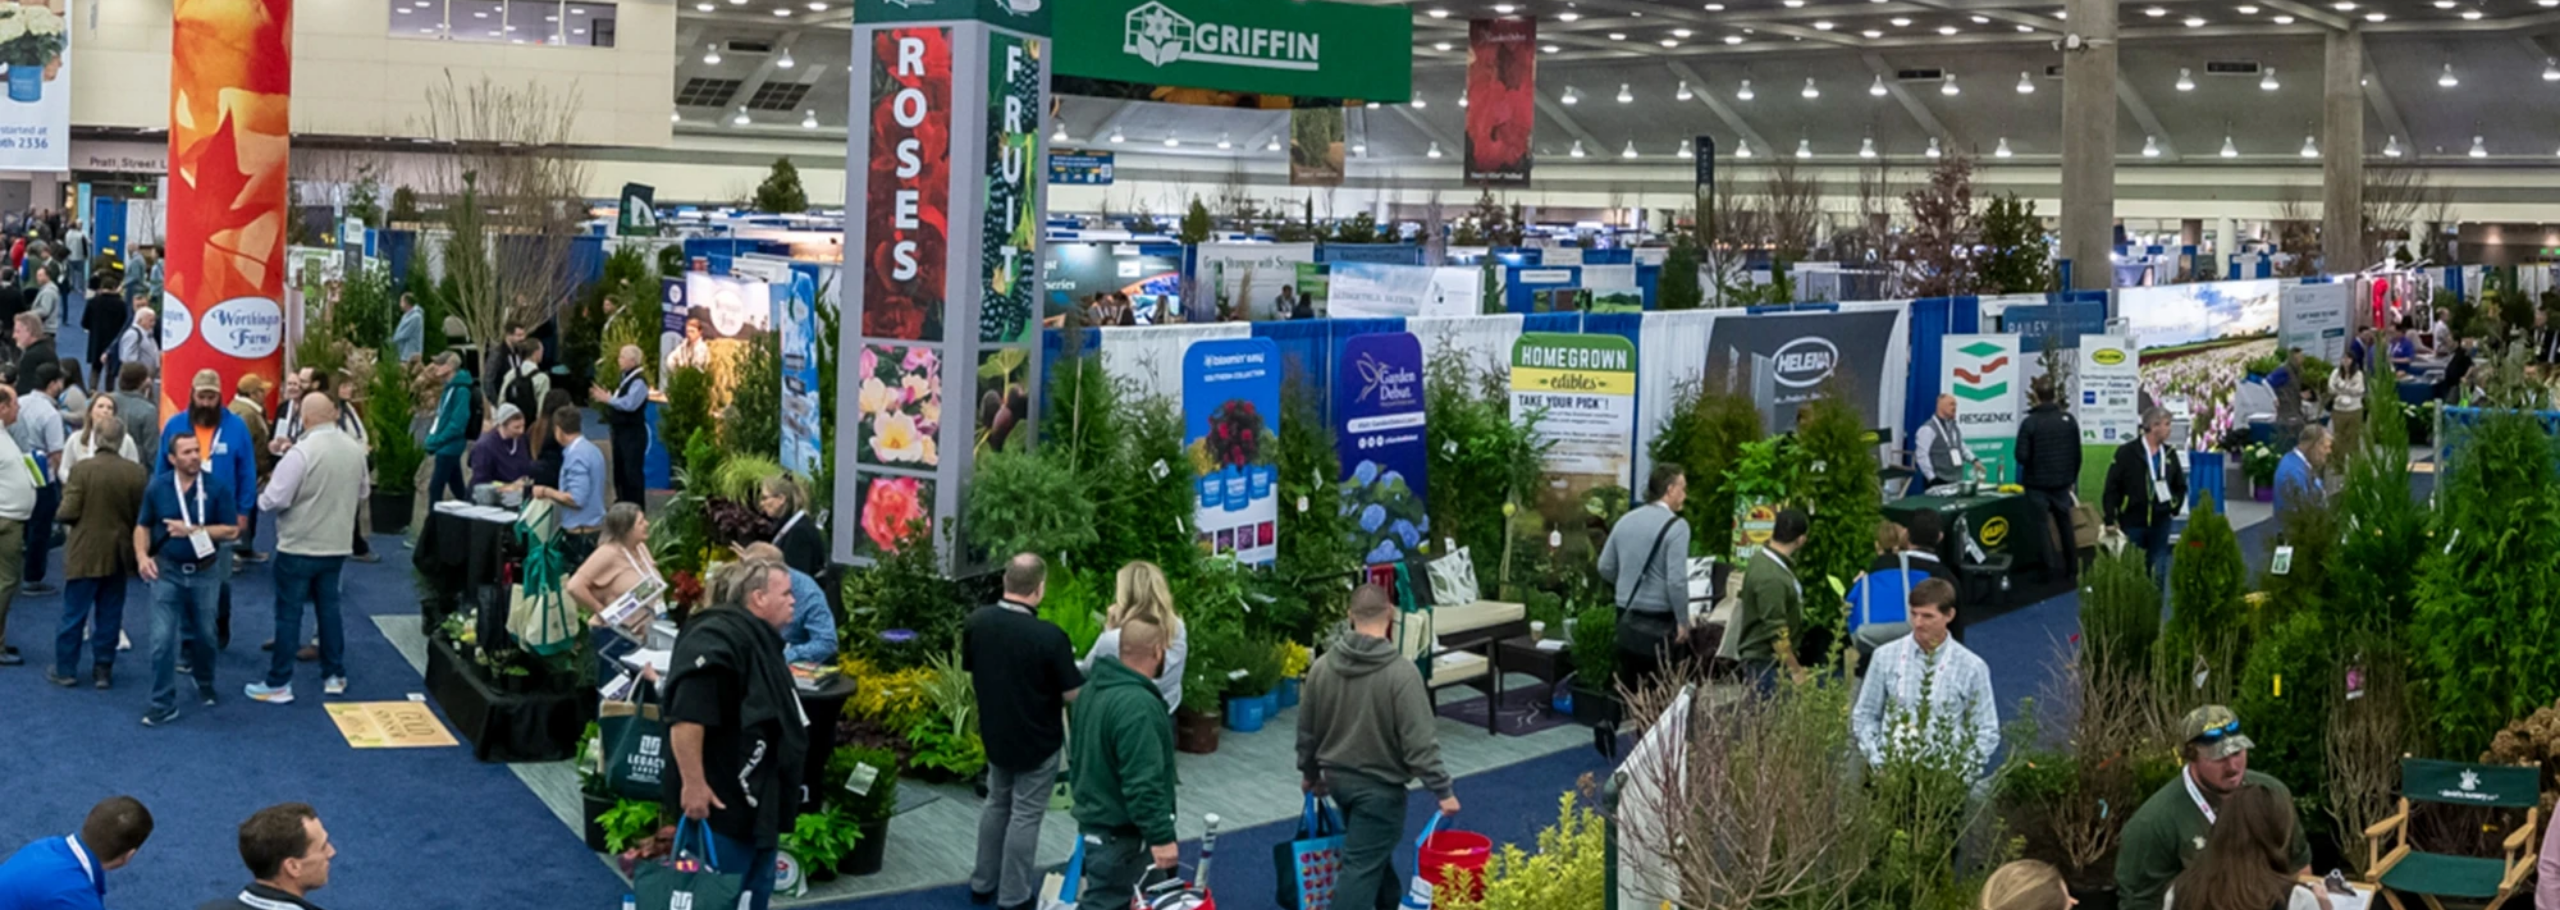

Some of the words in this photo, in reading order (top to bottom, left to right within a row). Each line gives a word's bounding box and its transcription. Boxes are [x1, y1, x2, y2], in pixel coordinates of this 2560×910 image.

[1196, 22, 1319, 60] GRIFFIN
[18, 138, 49, 149] 2336
[89, 156, 117, 167] Pratt
[121, 157, 156, 169] Street
[893, 37, 928, 281] ROSES
[1000, 45, 1023, 283] FRUIT
[229, 328, 272, 350] Farms
[1521, 346, 1628, 370] HOMEGROWN
[1778, 351, 1832, 373] HELENA
[1379, 366, 1417, 384] Garden
[1550, 373, 1597, 391] edibles
[1518, 394, 1543, 407] TAKE
[1546, 395, 1574, 409] YOUR
[1959, 411, 2015, 426] RESGENIX
